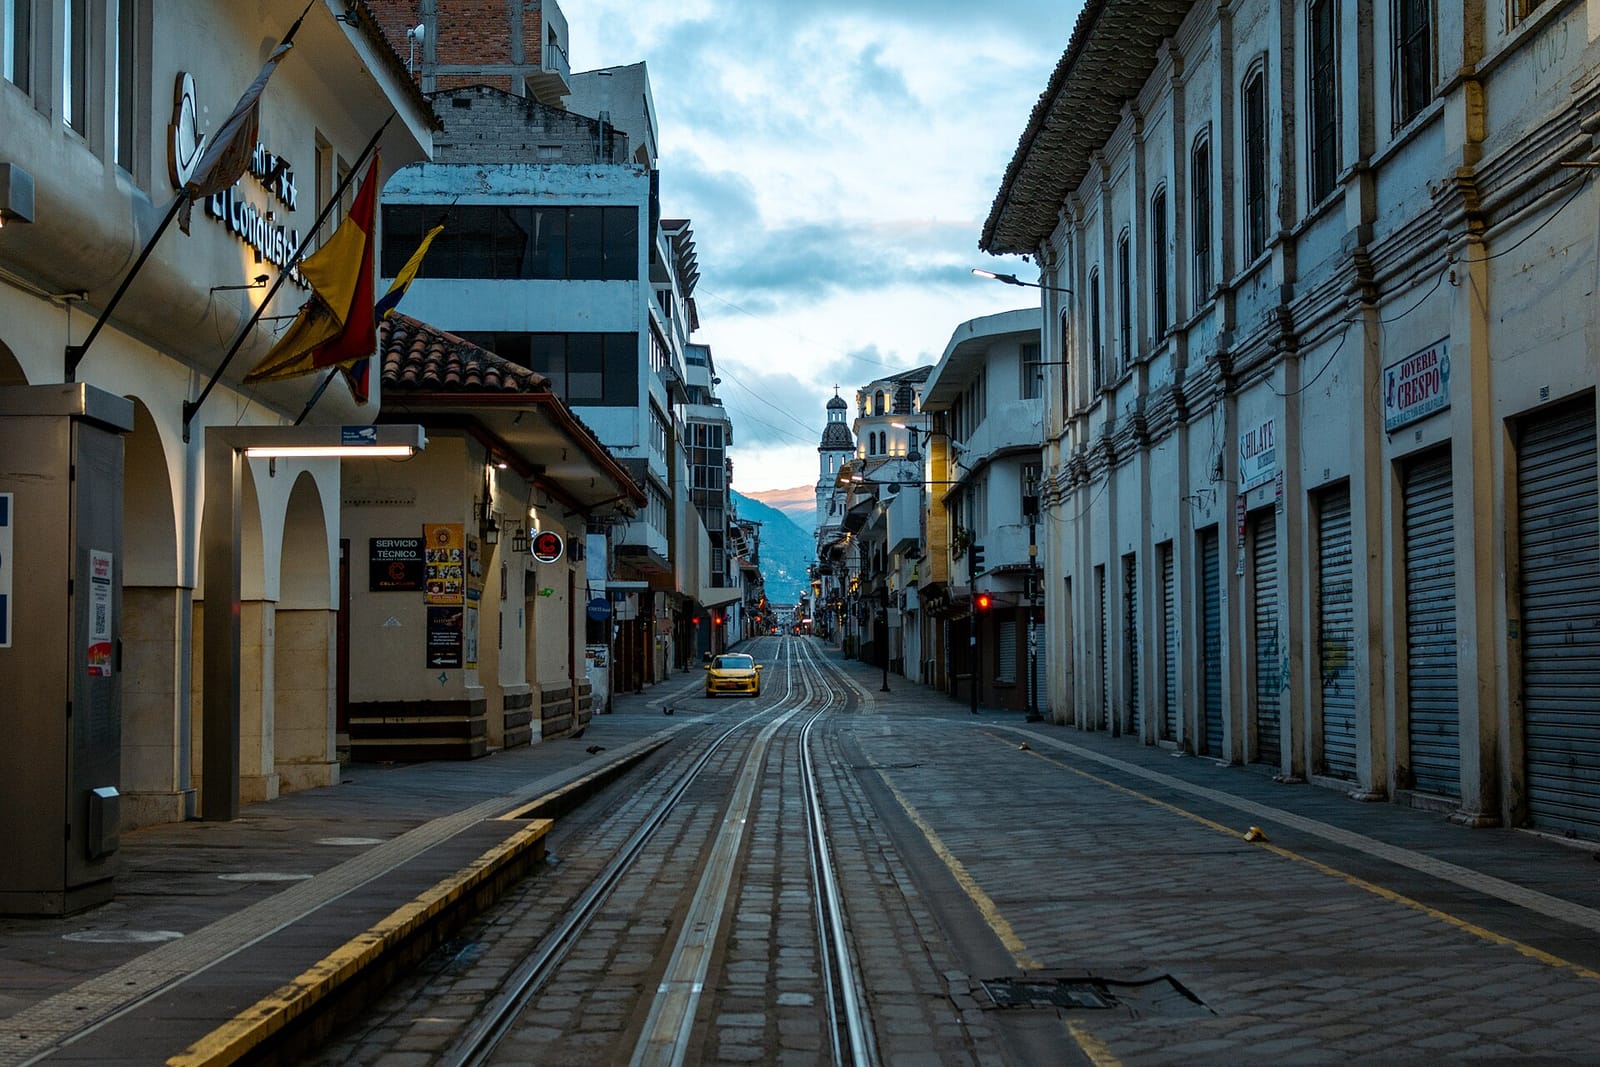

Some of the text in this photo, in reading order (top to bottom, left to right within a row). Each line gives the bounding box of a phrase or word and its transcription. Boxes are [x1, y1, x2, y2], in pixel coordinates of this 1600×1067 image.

[1399, 348, 1438, 382] JOYERIA
[1397, 367, 1440, 411] CRESPO
[375, 539, 418, 548] SERVICIO
